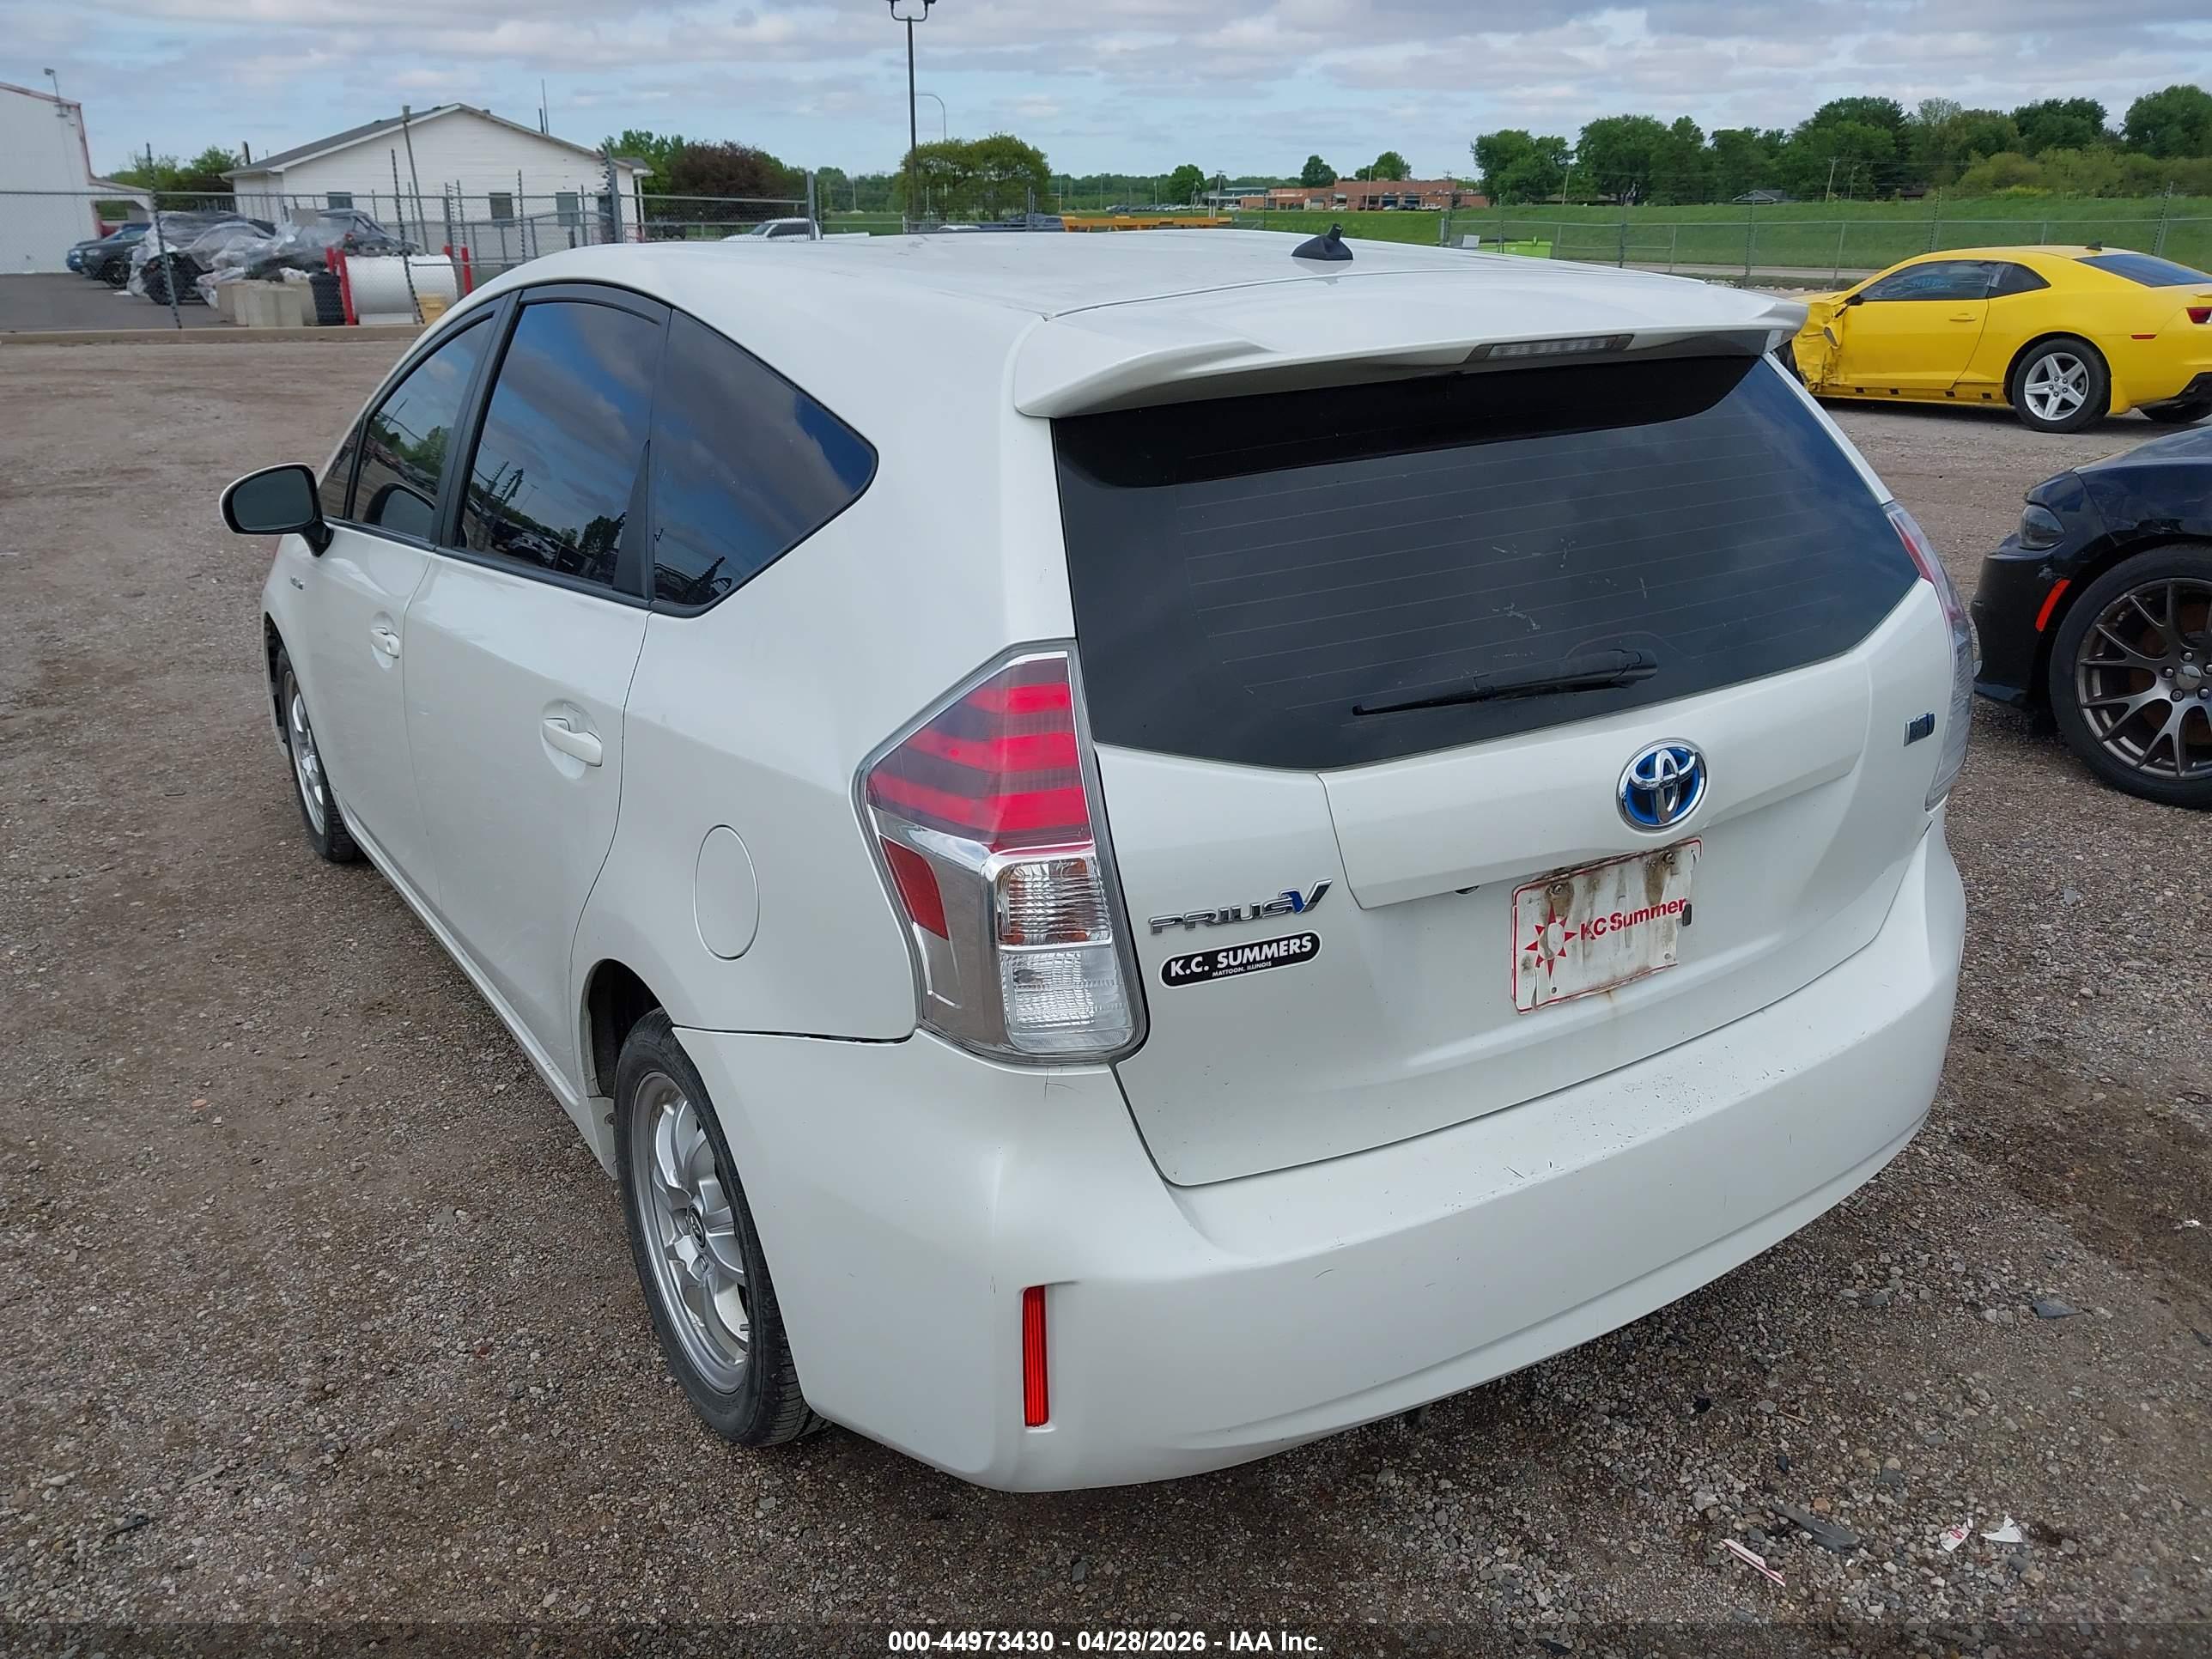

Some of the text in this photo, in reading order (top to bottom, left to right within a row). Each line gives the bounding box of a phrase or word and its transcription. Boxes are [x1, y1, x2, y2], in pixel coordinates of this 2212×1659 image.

[1148, 898, 1293, 935] PRIUS
[1170, 935, 1312, 977] K.C. SUMMERS
[1212, 960, 1273, 978] MATTOON, ILLINOIS
